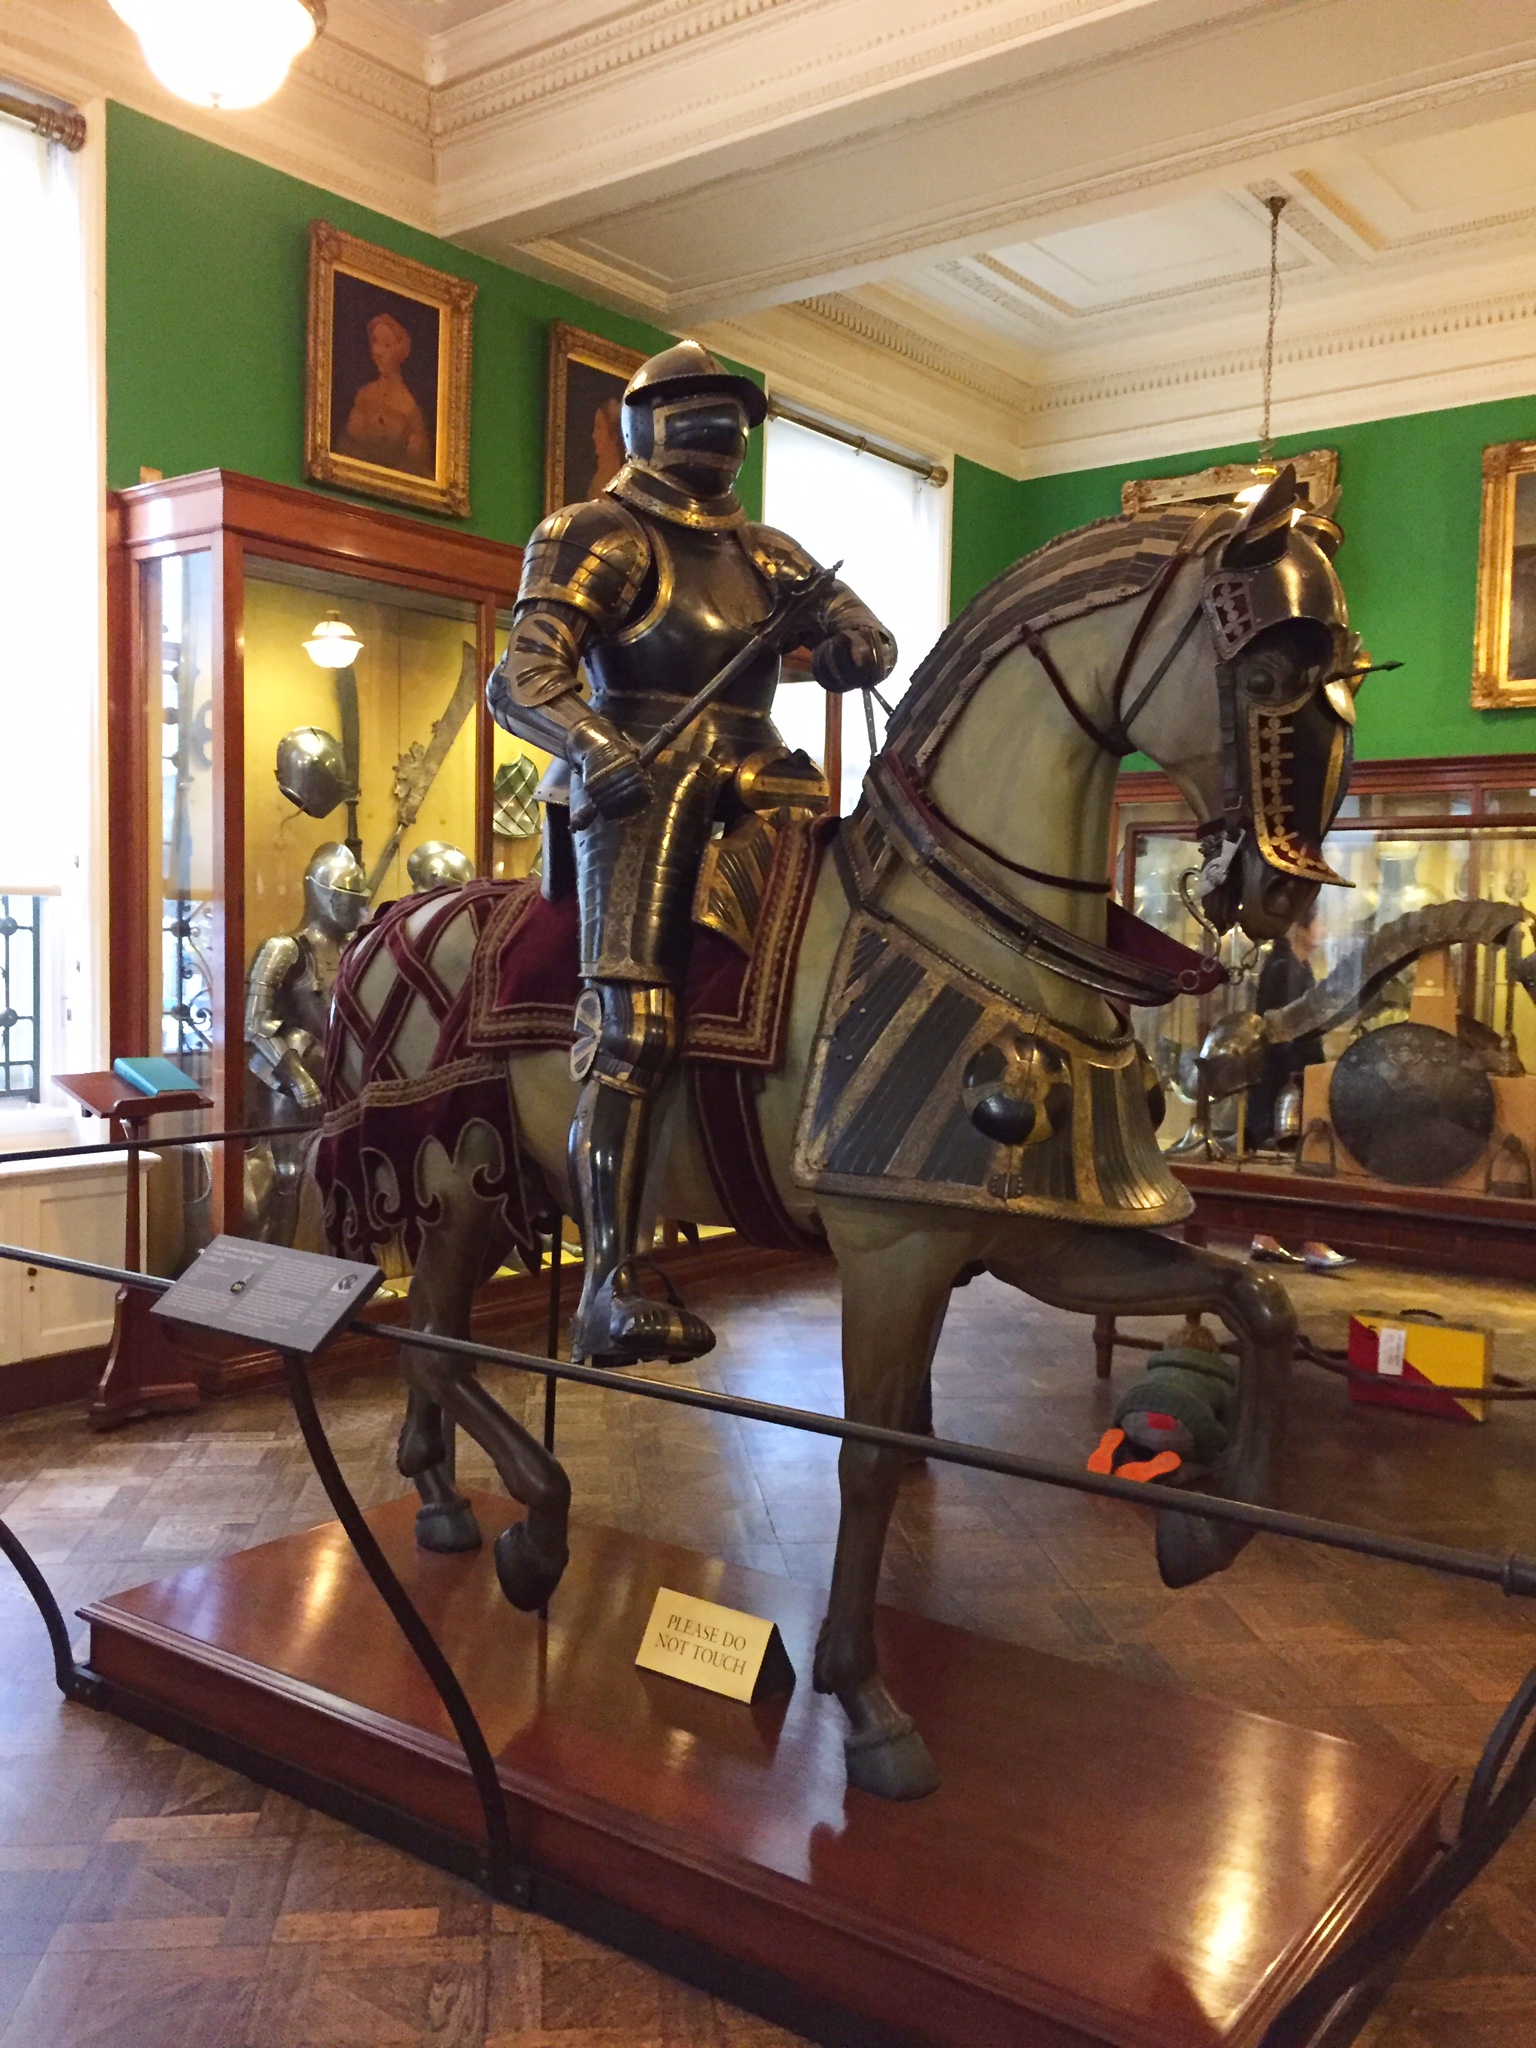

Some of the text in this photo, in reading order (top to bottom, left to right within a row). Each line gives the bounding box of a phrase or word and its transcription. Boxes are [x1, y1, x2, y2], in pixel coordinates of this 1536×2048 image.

[667, 1614, 747, 1651] PLEASE DO
[655, 1632, 747, 1676] NOT TOUCH
